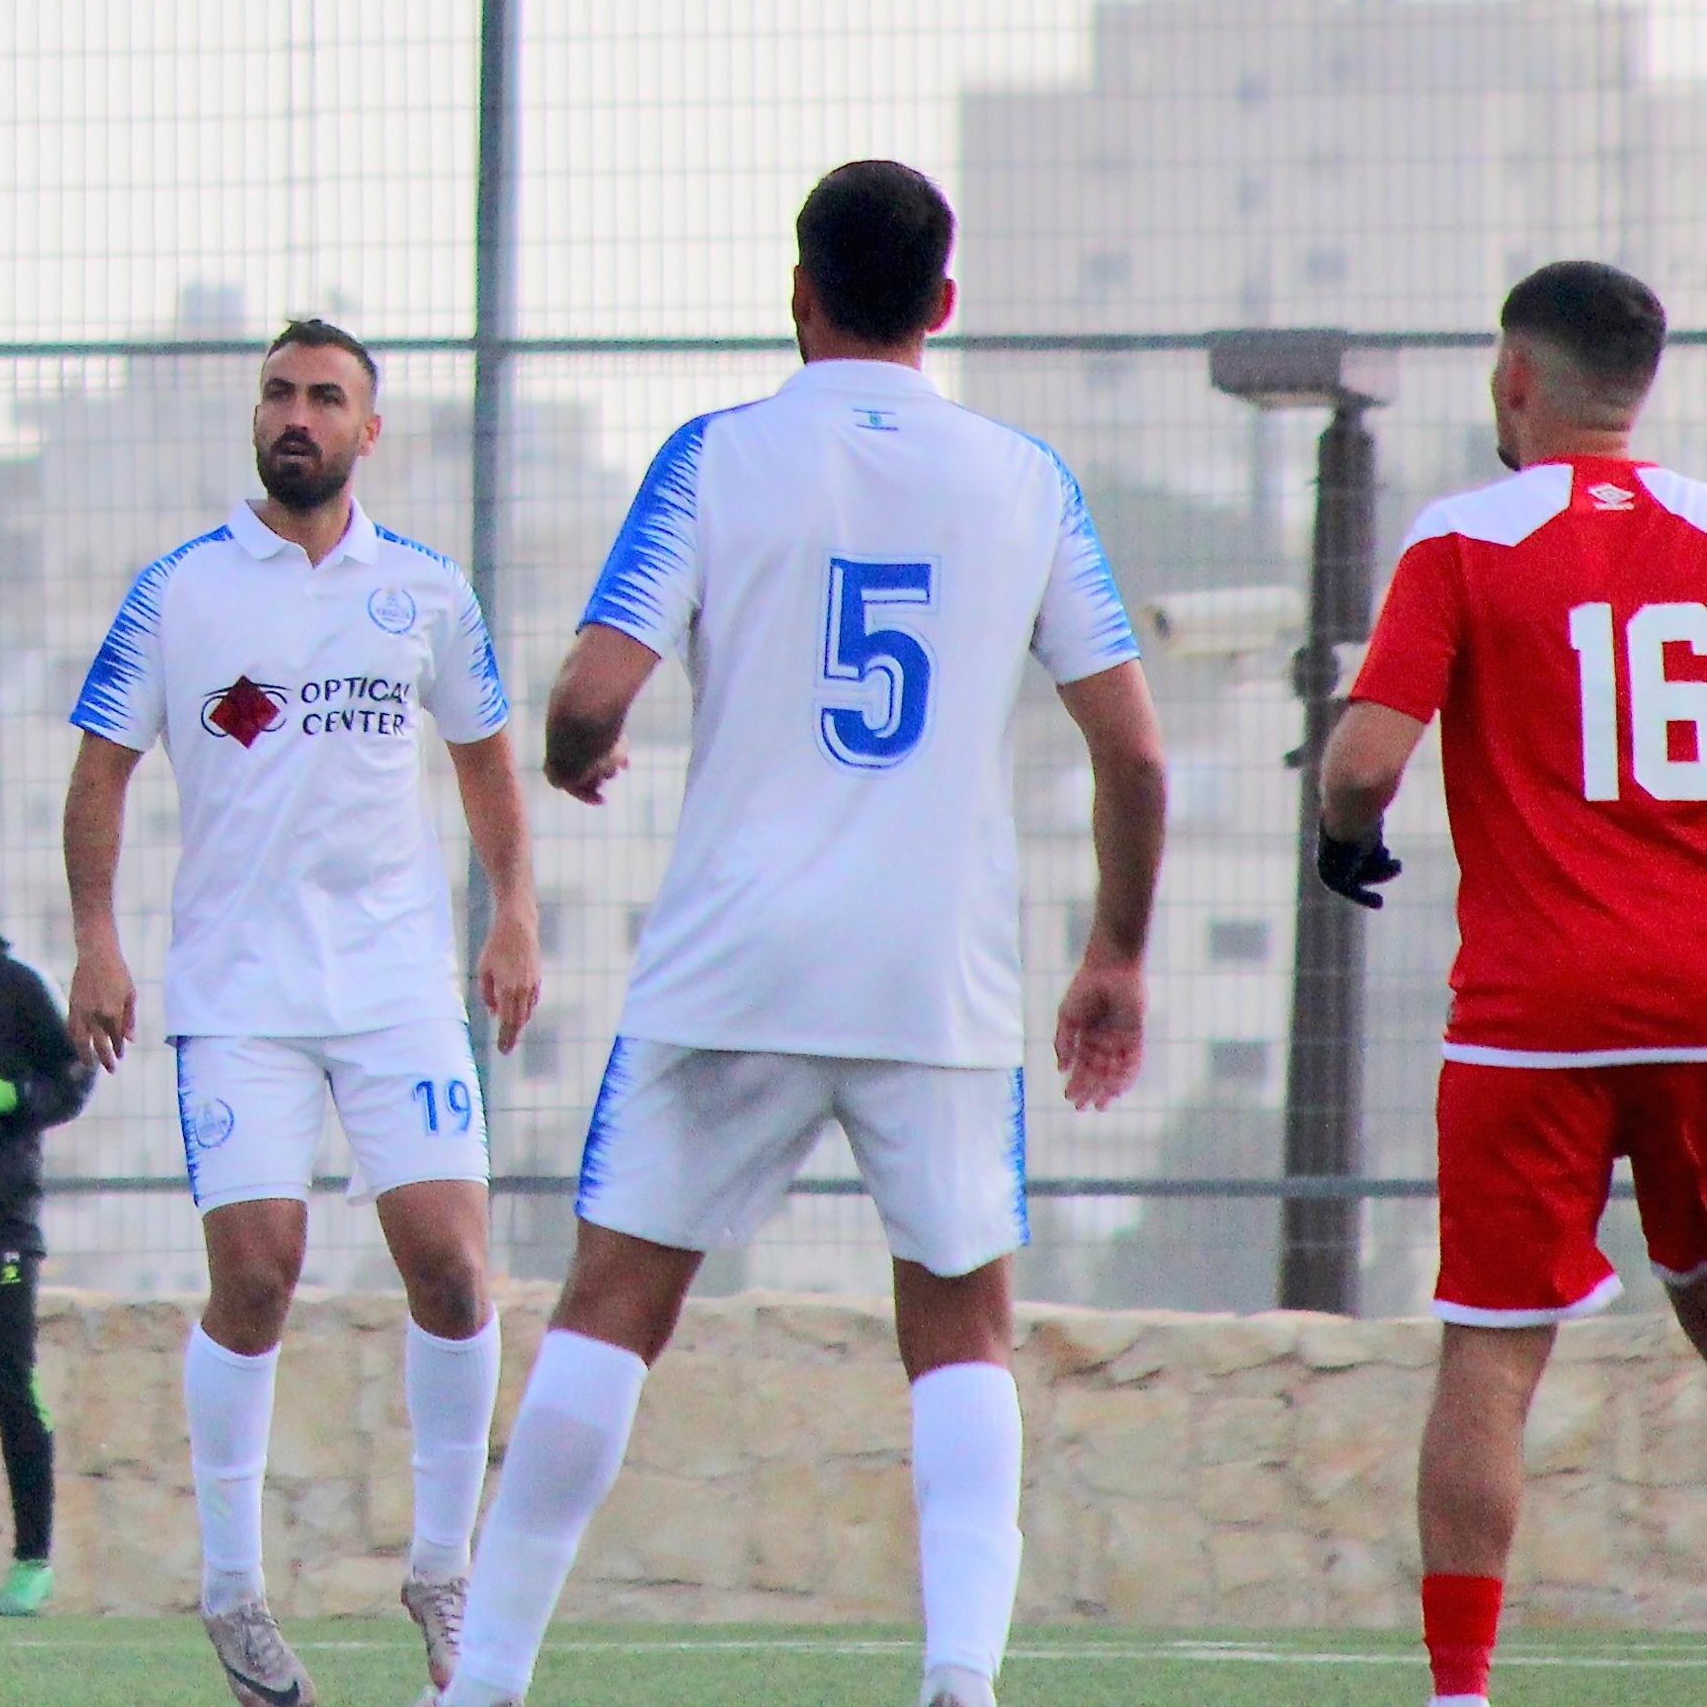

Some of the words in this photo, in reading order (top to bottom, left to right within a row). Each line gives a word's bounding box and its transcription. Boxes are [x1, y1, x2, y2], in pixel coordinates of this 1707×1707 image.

[301, 709, 405, 736] CENTER
[817, 554, 935, 772] 5
[1567, 600, 1707, 802] 16
[412, 1078, 473, 1134] 19
